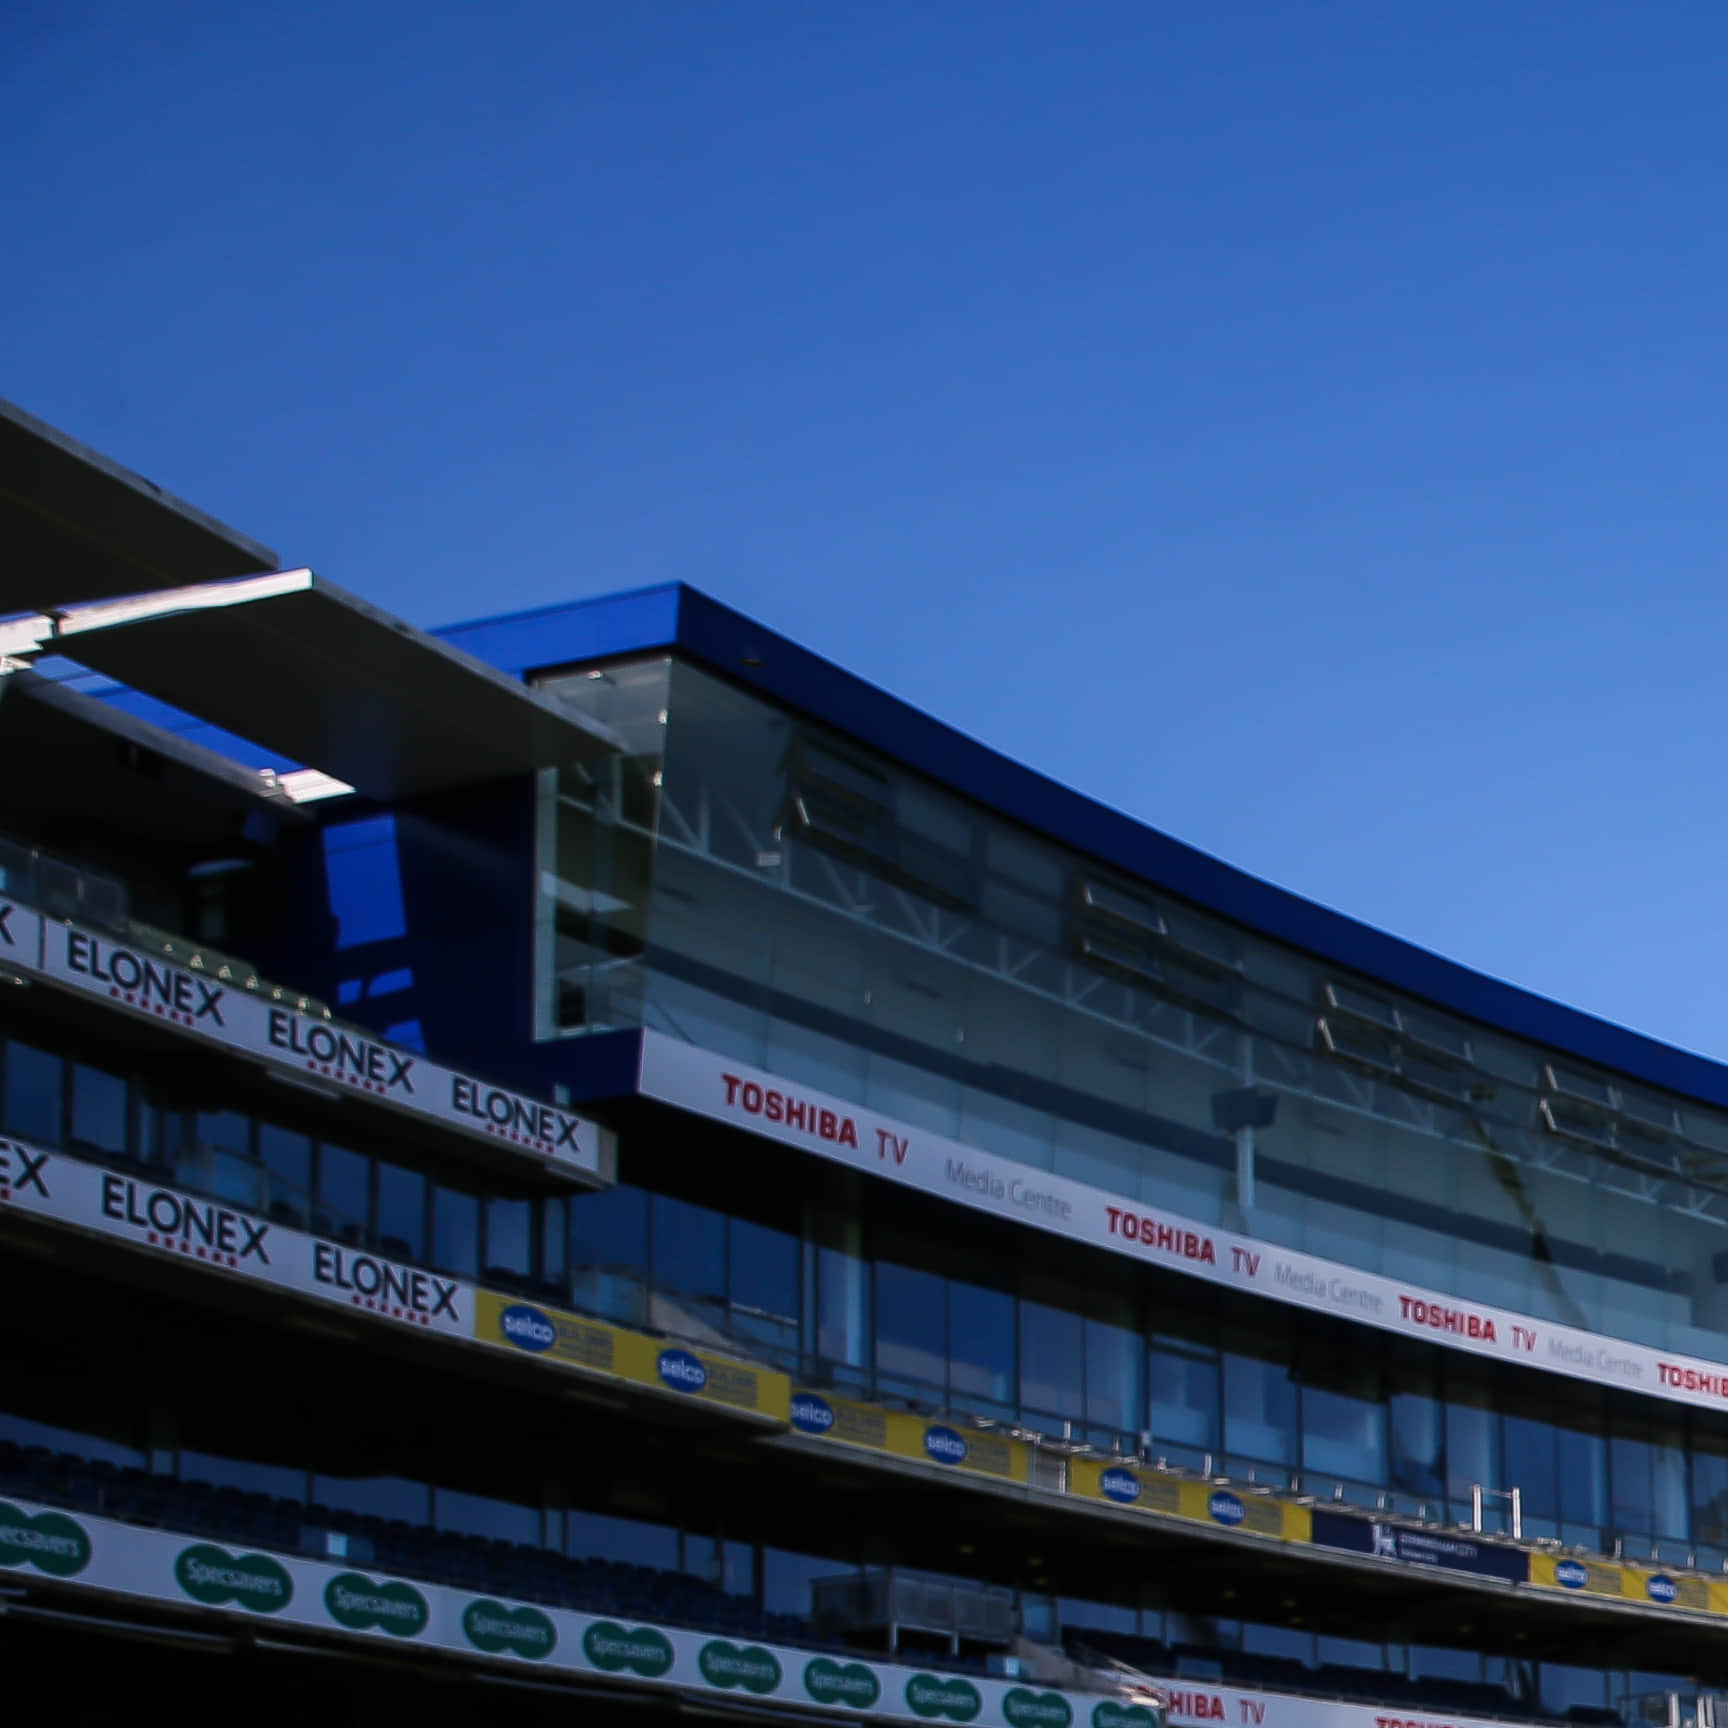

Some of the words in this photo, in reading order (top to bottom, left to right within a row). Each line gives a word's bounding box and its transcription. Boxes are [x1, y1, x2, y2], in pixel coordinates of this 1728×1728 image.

[66, 931, 226, 1027] ELONEX
[268, 1009, 417, 1094] ELONEX
[451, 1072, 581, 1153] ELONEX
[101, 1173, 271, 1265] ELONEX
[720, 1072, 859, 1150] TOSHIBA
[875, 1128, 909, 1166] TV
[946, 1157, 1004, 1197] Media
[1010, 1178, 1073, 1222] Centre
[1105, 1206, 1218, 1265] TOSHIBA
[1231, 1246, 1261, 1277] TV
[1399, 1294, 1497, 1344] TOSHIBA
[1512, 1326, 1537, 1353] TV
[312, 1241, 460, 1323] ELONEX
[503, 1315, 554, 1343] selco
[659, 1358, 706, 1384] selco
[186, 1555, 283, 1597] Specsavers
[335, 1583, 420, 1621] Specsavers
[470, 1611, 549, 1644] Specsavers
[591, 1630, 667, 1663] Specsavers
[1238, 1699, 1266, 1725] TV
